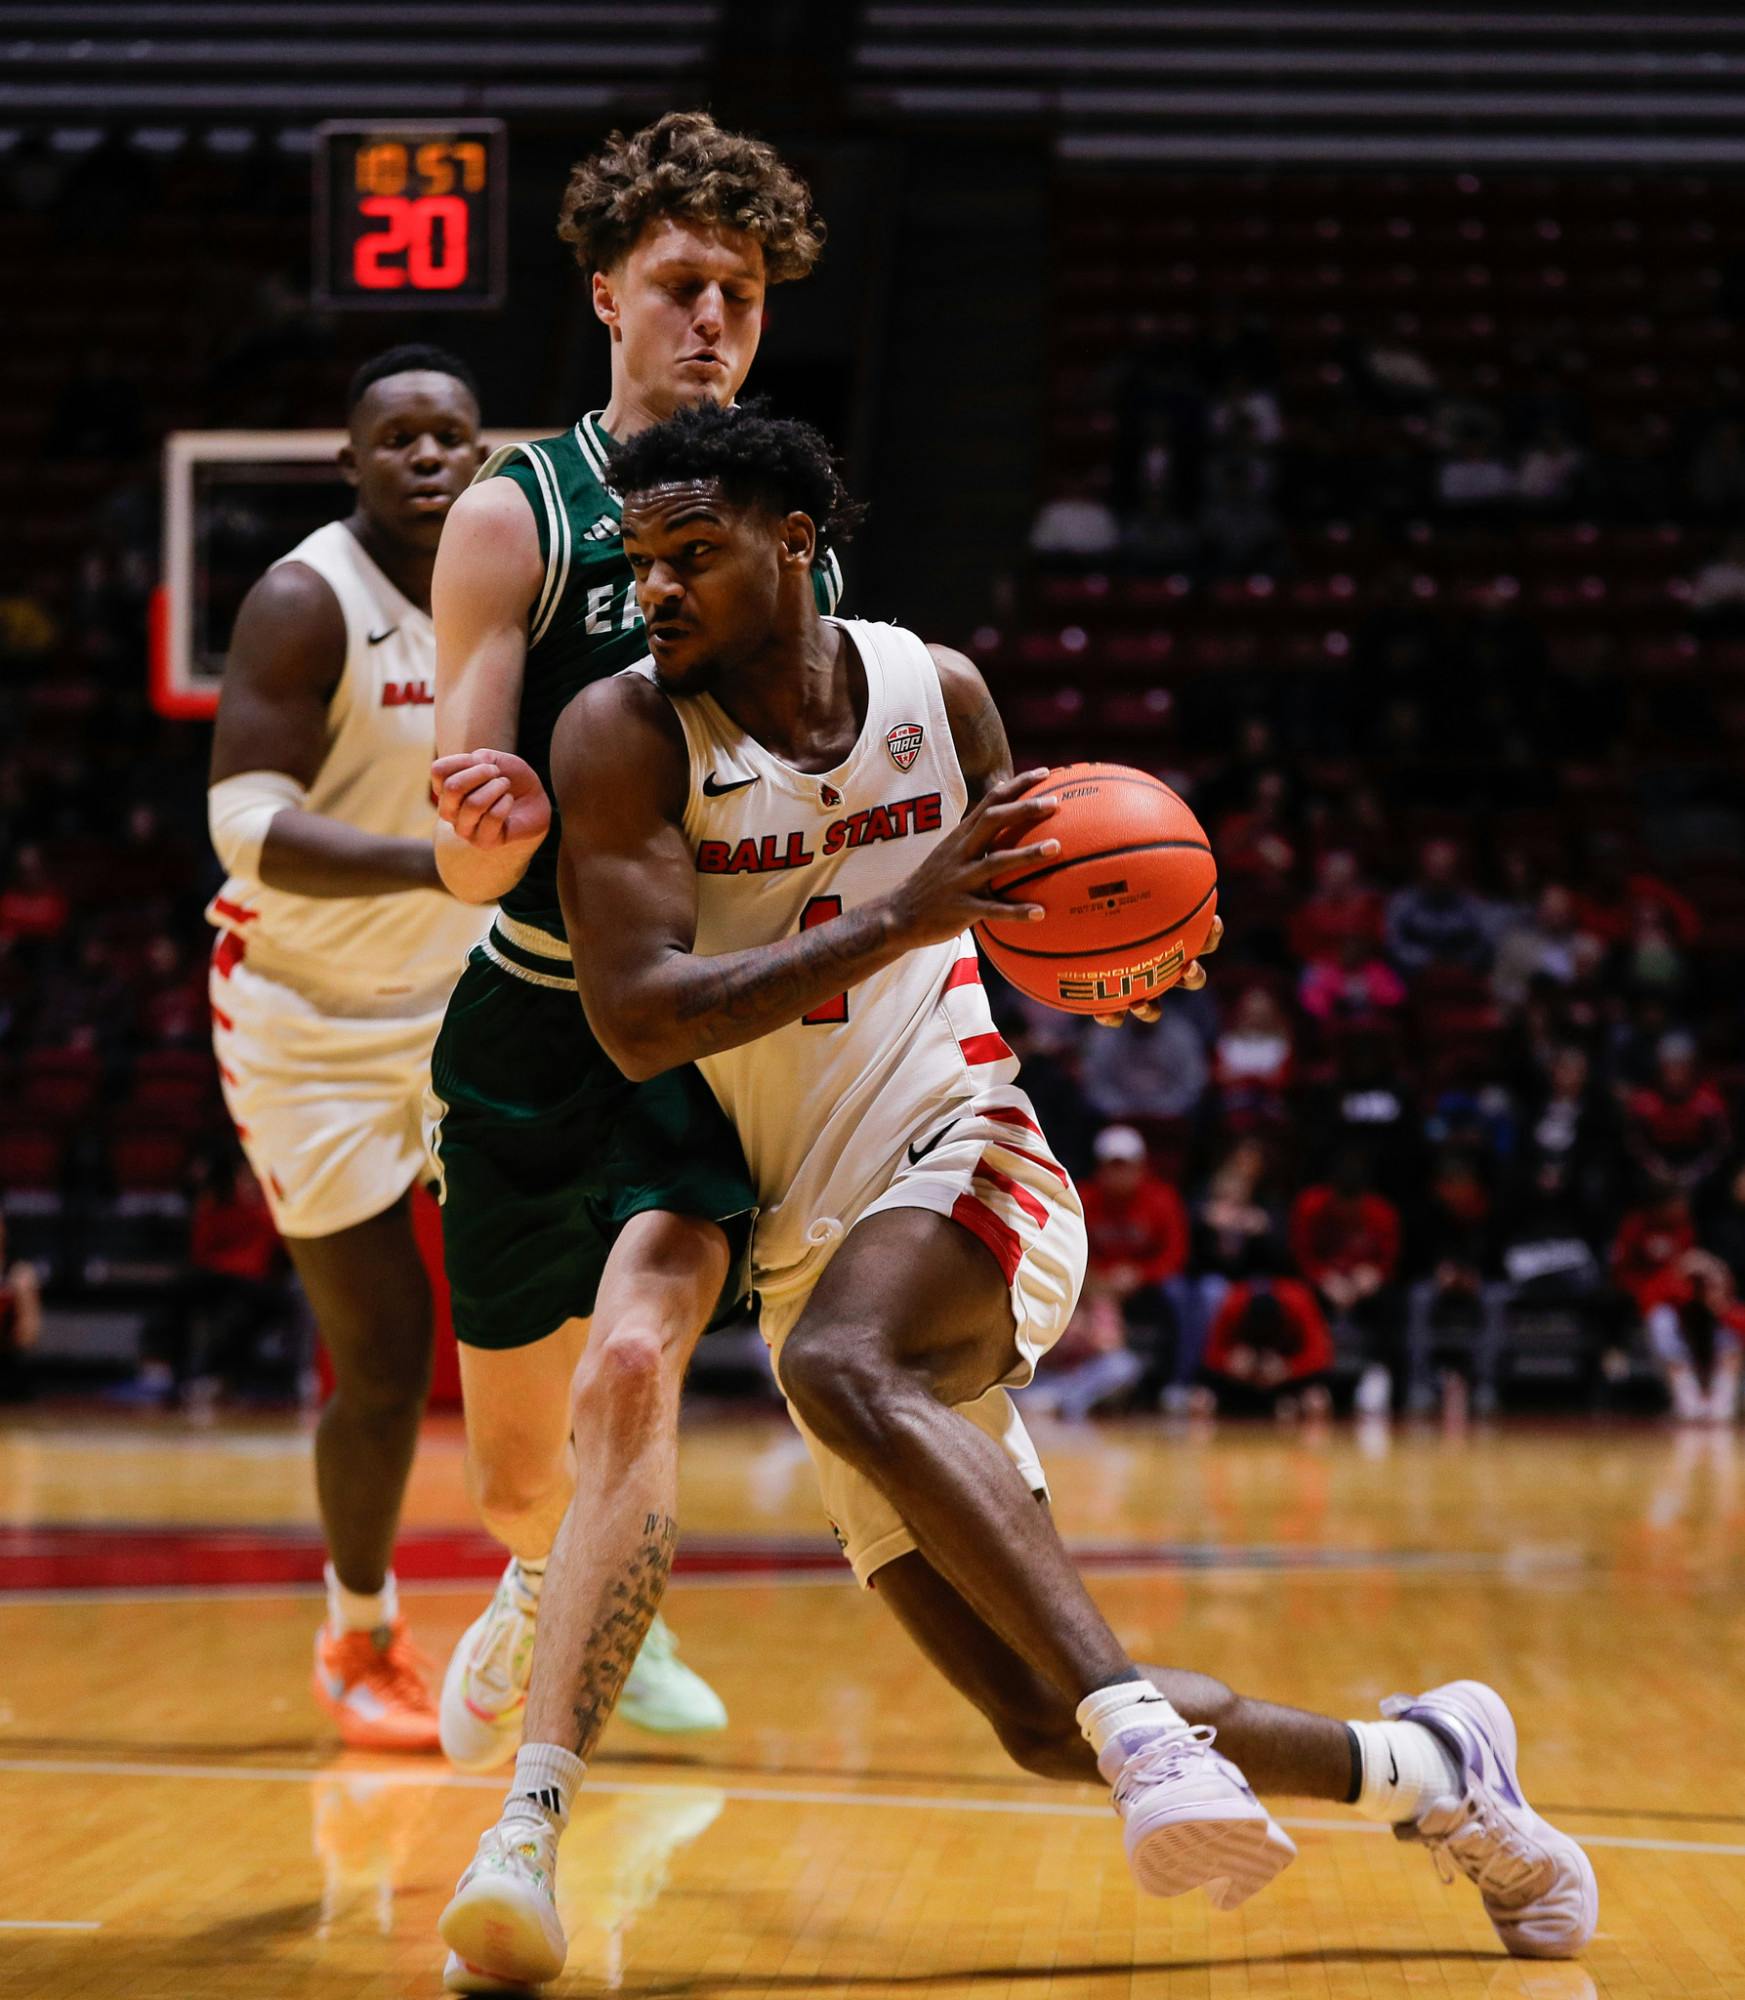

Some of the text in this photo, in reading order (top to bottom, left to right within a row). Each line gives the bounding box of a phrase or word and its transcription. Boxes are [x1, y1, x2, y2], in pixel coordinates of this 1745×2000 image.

[353, 195, 468, 289] 20
[381, 680, 435, 708] BAL
[890, 735, 922, 753] MAC
[696, 793, 942, 875] BALL STATE
[1057, 939, 1185, 980] CHAMPIONSHIP
[1057, 948, 1185, 1001] ELITE
